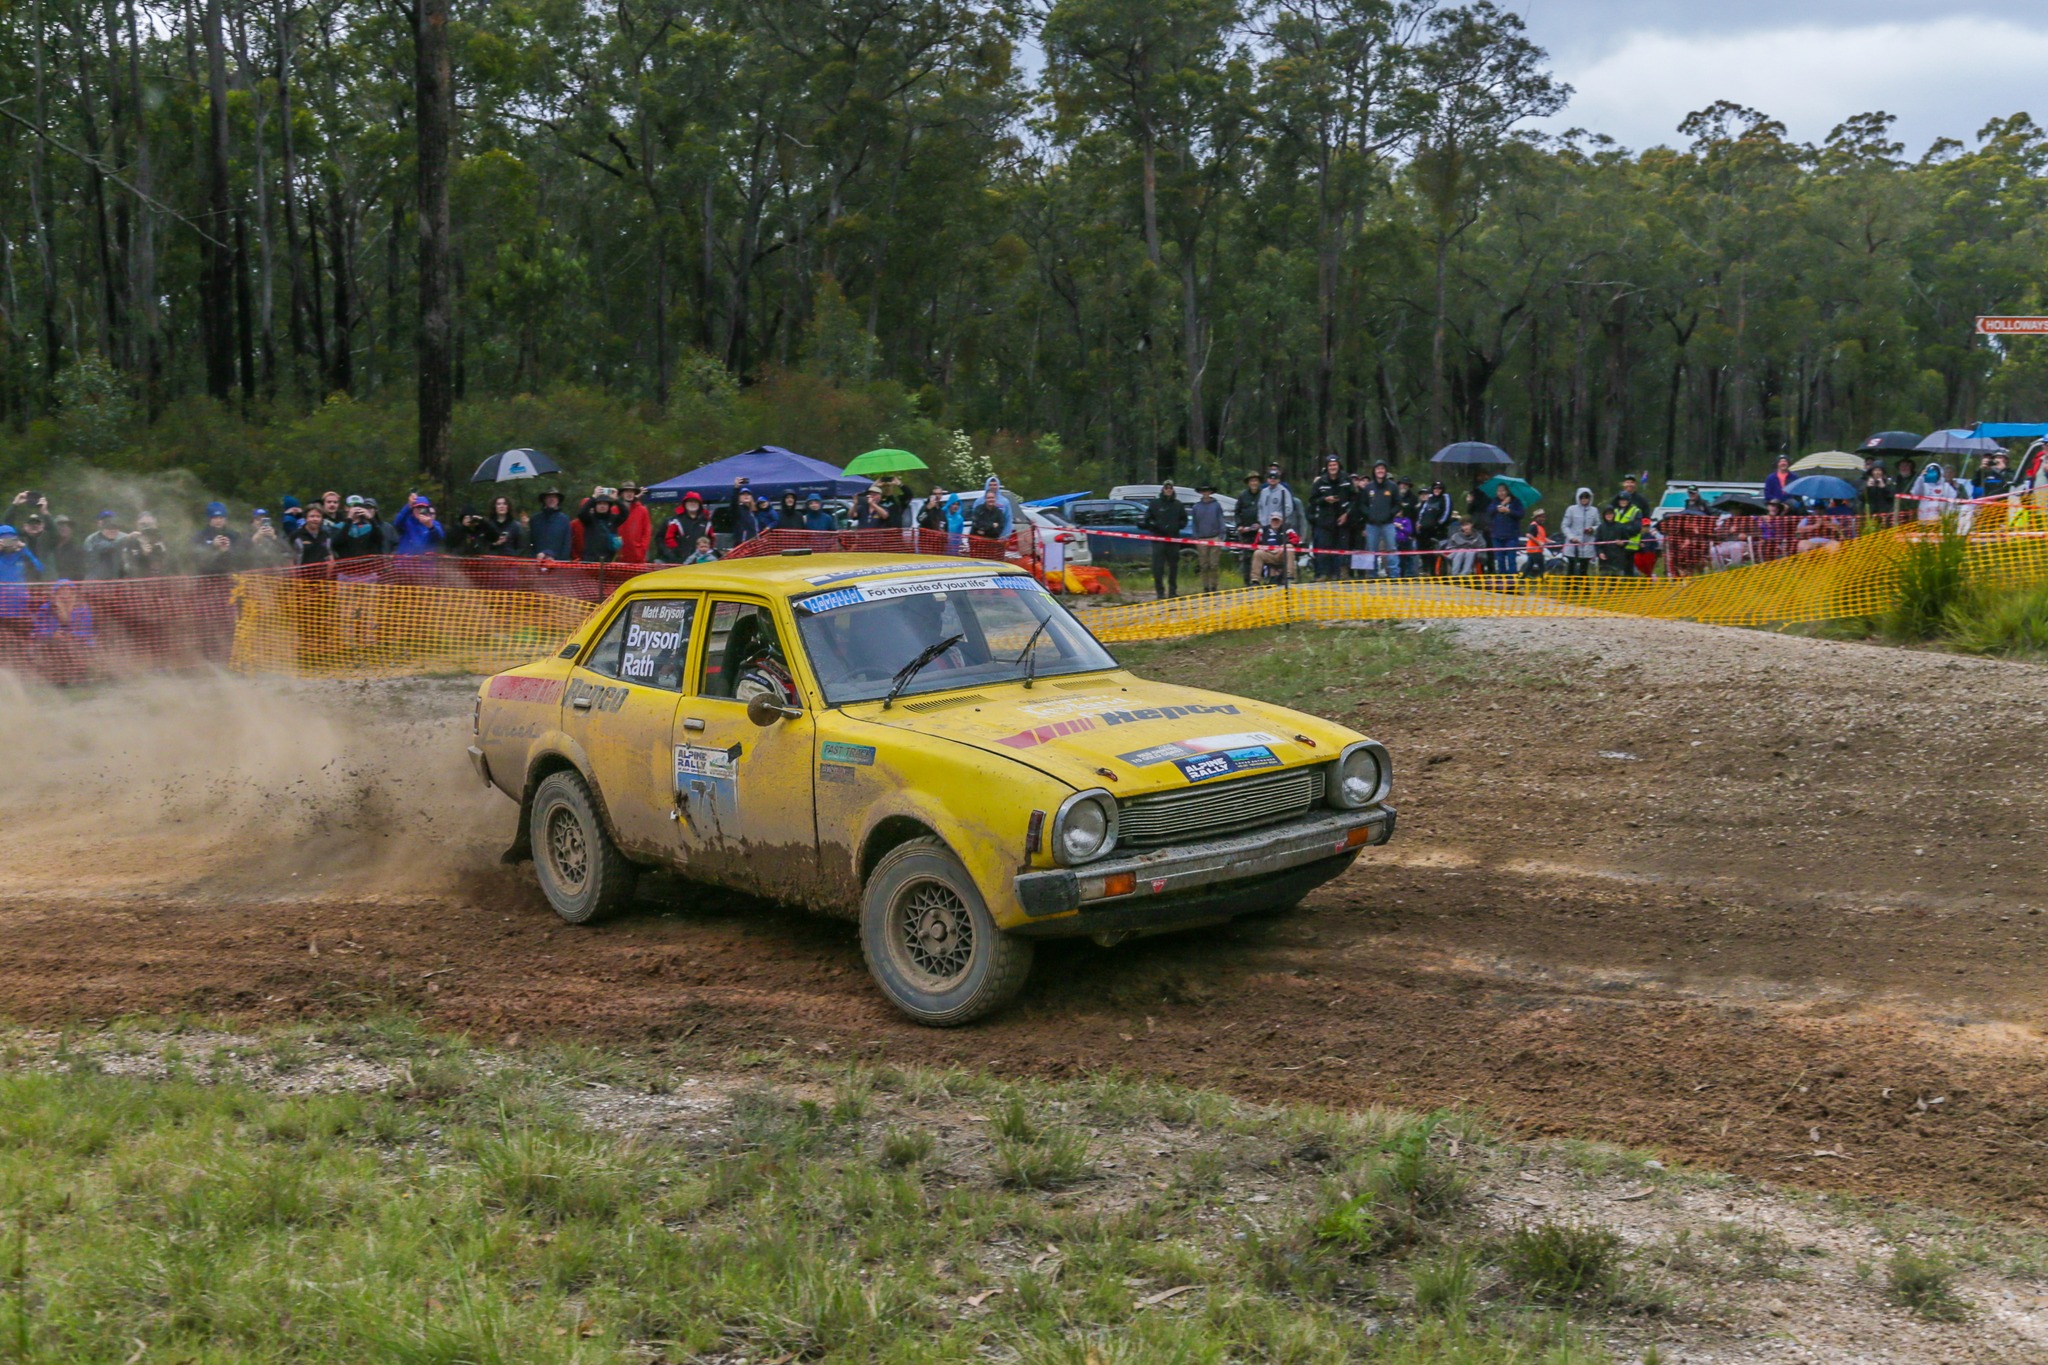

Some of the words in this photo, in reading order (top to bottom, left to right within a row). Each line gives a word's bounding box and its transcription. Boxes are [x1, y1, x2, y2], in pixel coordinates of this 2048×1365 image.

[867, 589, 886, 597] For
[888, 586, 907, 595] the
[908, 584, 931, 593] ride
[931, 582, 943, 590] of
[944, 581, 967, 591] your
[642, 605, 659, 618] Matt
[659, 606, 685, 621] Bryson
[627, 624, 679, 653] Bryson
[622, 653, 654, 677] Rath
[678, 749, 707, 761] ALPINE
[825, 745, 844, 755] FAST
[678, 759, 707, 770] RALLY
[1185, 758, 1227, 773] ALPINE
[1189, 764, 1229, 778] RALLY
